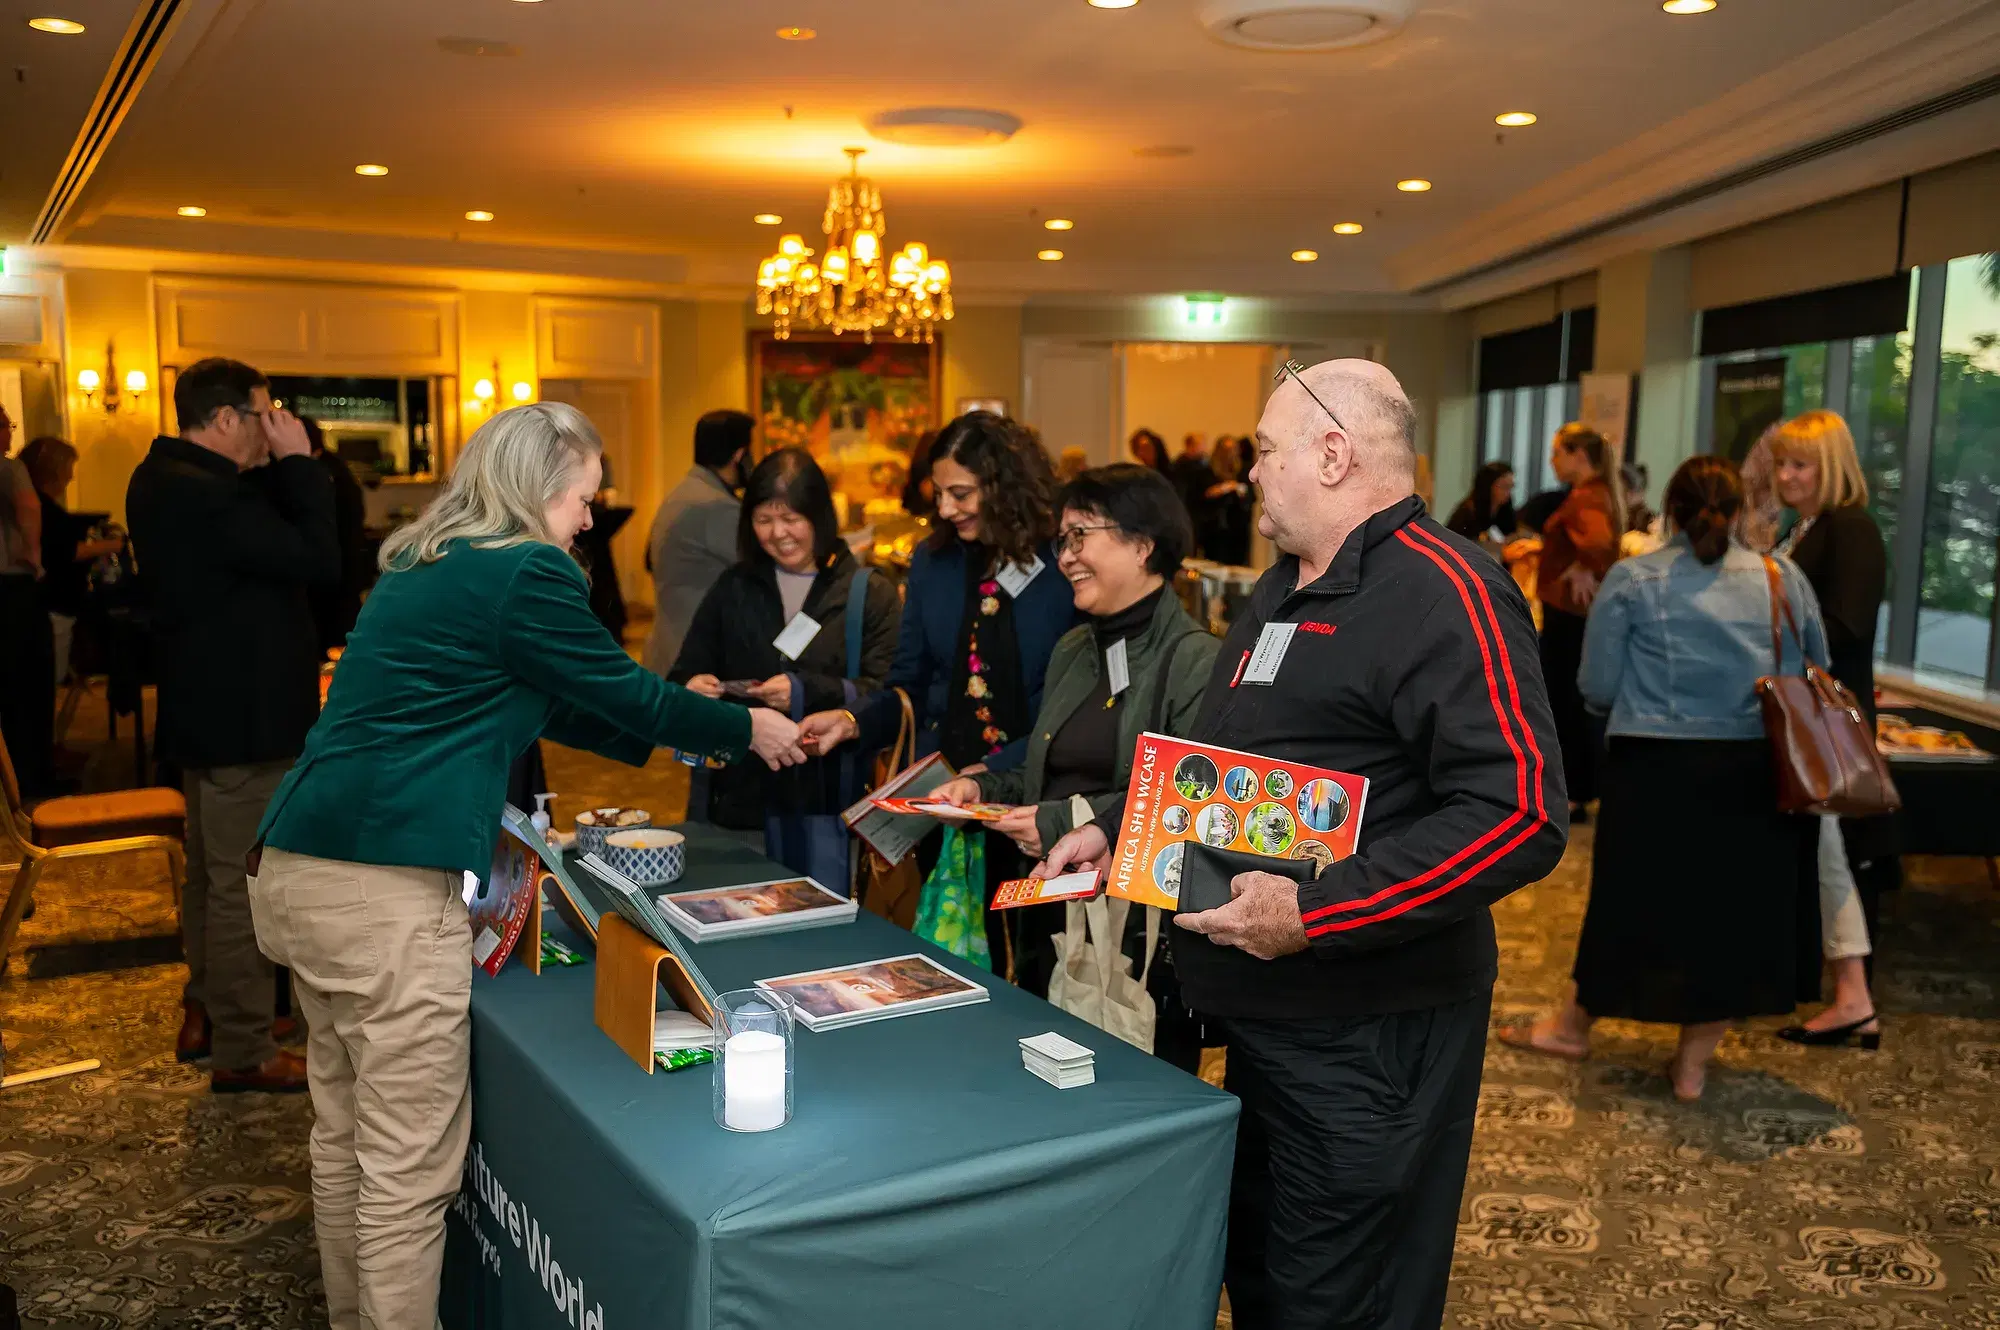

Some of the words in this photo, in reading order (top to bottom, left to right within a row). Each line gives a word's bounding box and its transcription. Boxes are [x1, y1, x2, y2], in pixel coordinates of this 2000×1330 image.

[1157, 770, 1166, 786] 2024
[1152, 786, 1163, 816] ZEALAND
[1116, 836, 1140, 892] AFRICA
[1130, 745, 1157, 835] SHOWCASE
[1148, 817, 1157, 831] NEW
[1139, 838, 1152, 872] AUSTRALIA
[524, 856, 535, 898] AFRICA
[521, 1202, 604, 1330] World
